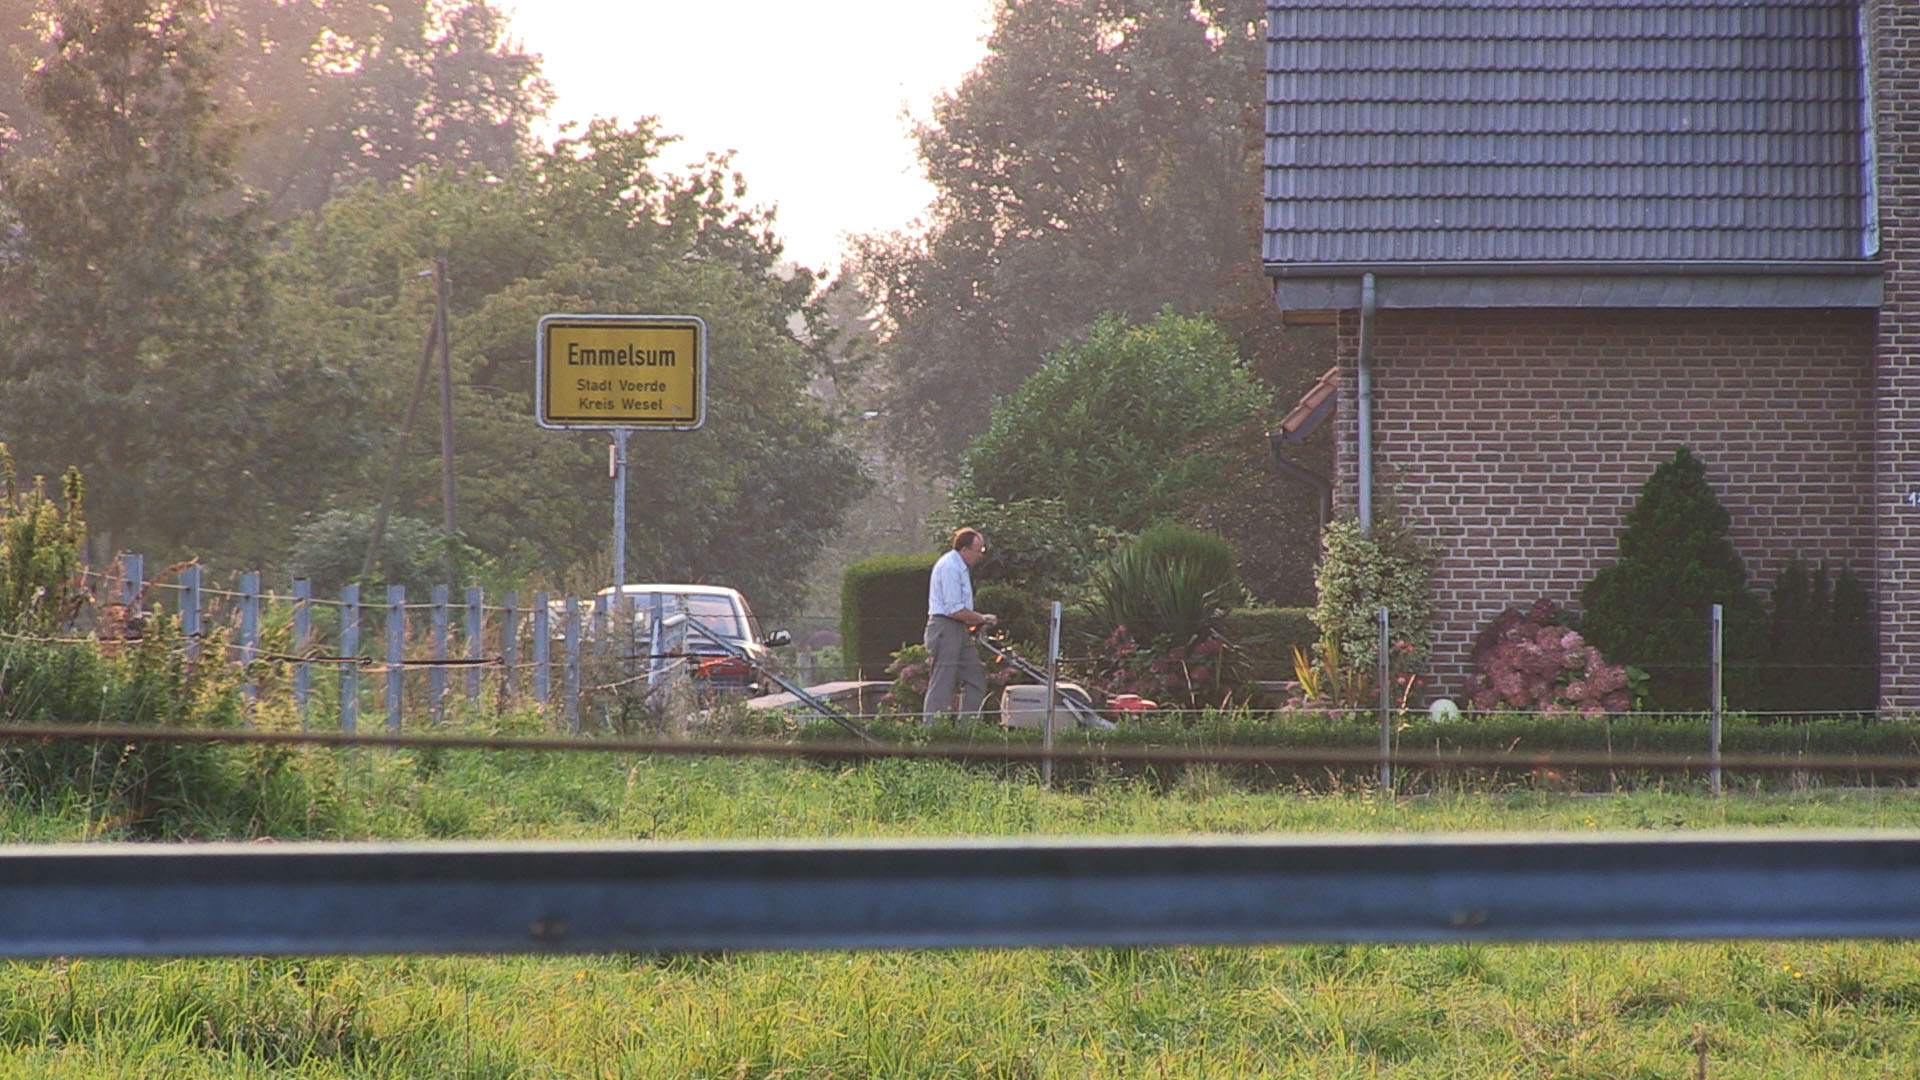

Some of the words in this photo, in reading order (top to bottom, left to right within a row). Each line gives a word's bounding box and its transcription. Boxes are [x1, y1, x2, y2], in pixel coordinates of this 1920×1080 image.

[568, 343, 675, 366] Emmelsum
[577, 378, 612, 391] Stadt
[619, 379, 666, 392] Voerde
[579, 398, 615, 410] Kreis
[622, 398, 663, 410] Wesel
